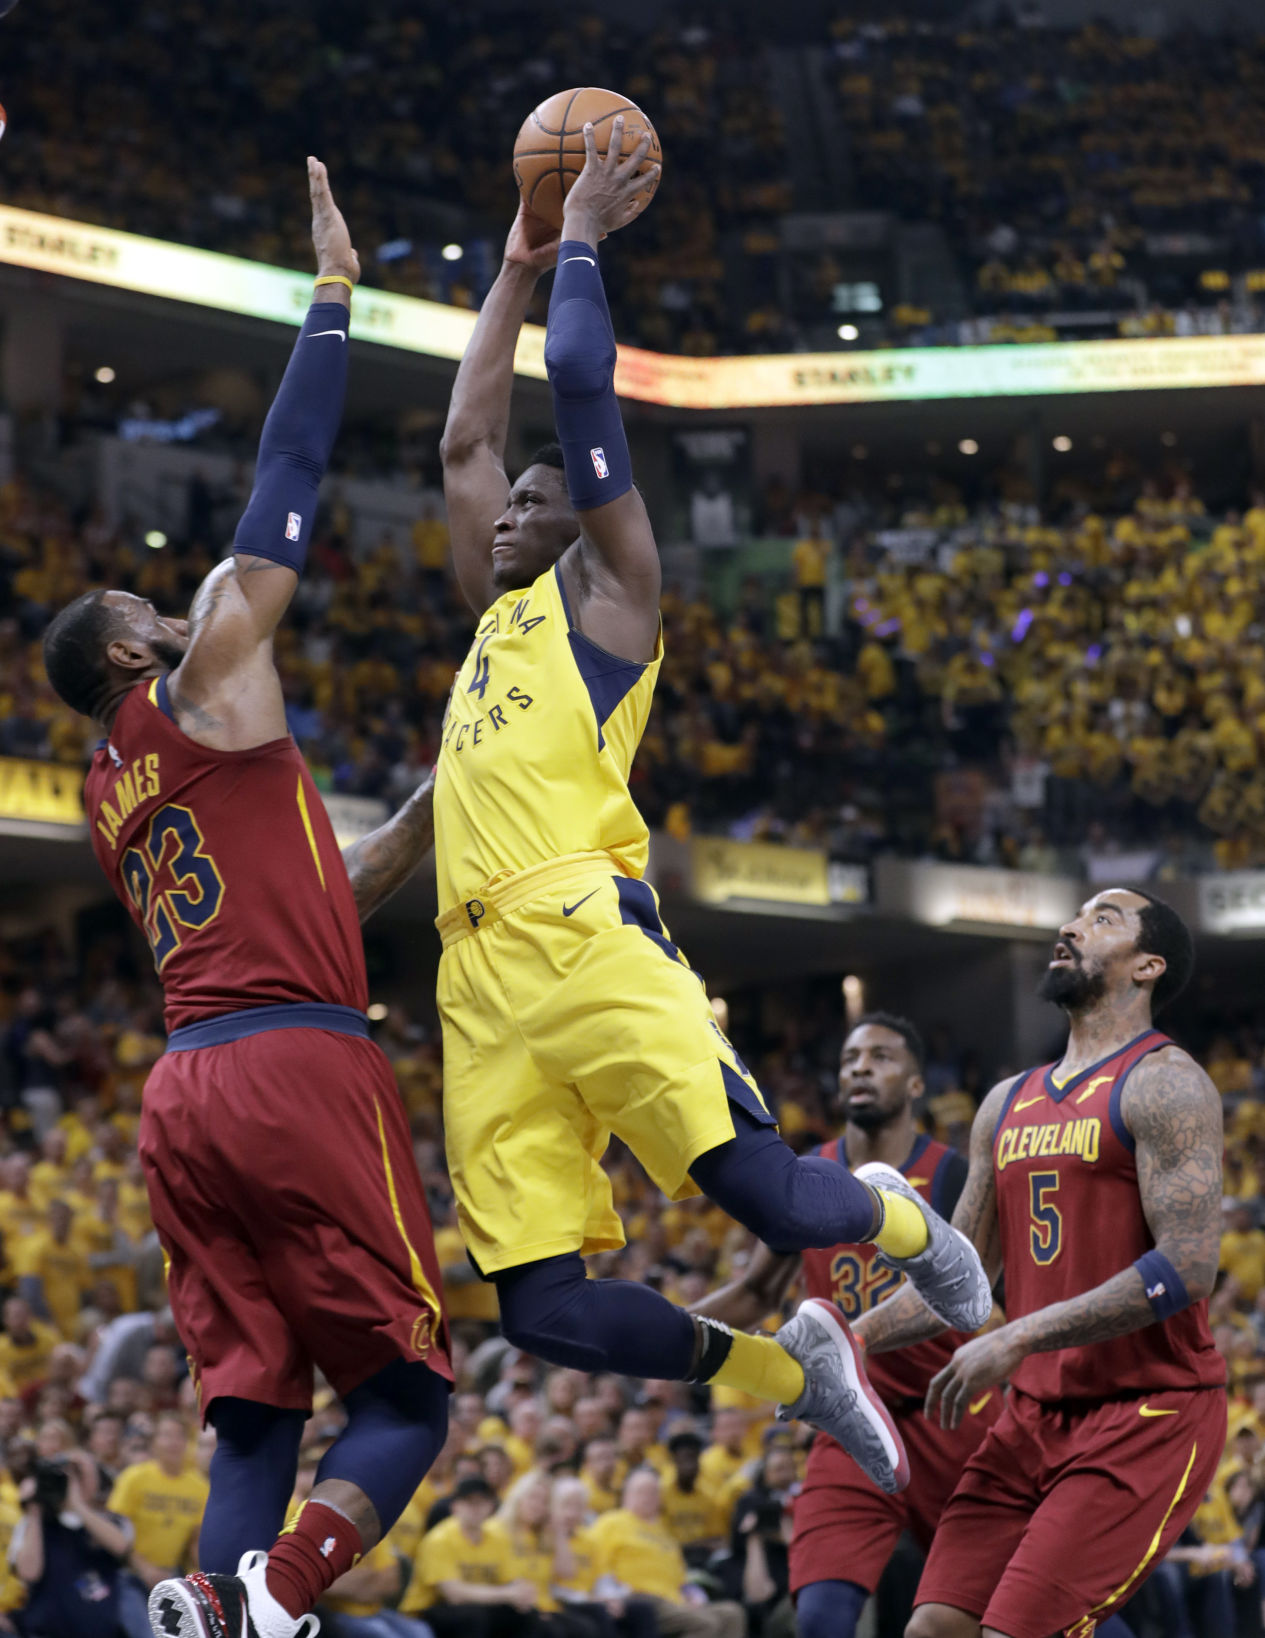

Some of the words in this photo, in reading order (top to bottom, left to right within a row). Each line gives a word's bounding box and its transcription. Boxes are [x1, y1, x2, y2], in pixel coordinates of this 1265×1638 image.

[97, 753, 160, 850] JAMES
[120, 803, 226, 976] 23
[997, 1117, 1101, 1171] CLEVELAND
[1028, 1170, 1062, 1266] 5
[830, 1250, 908, 1319] 32
